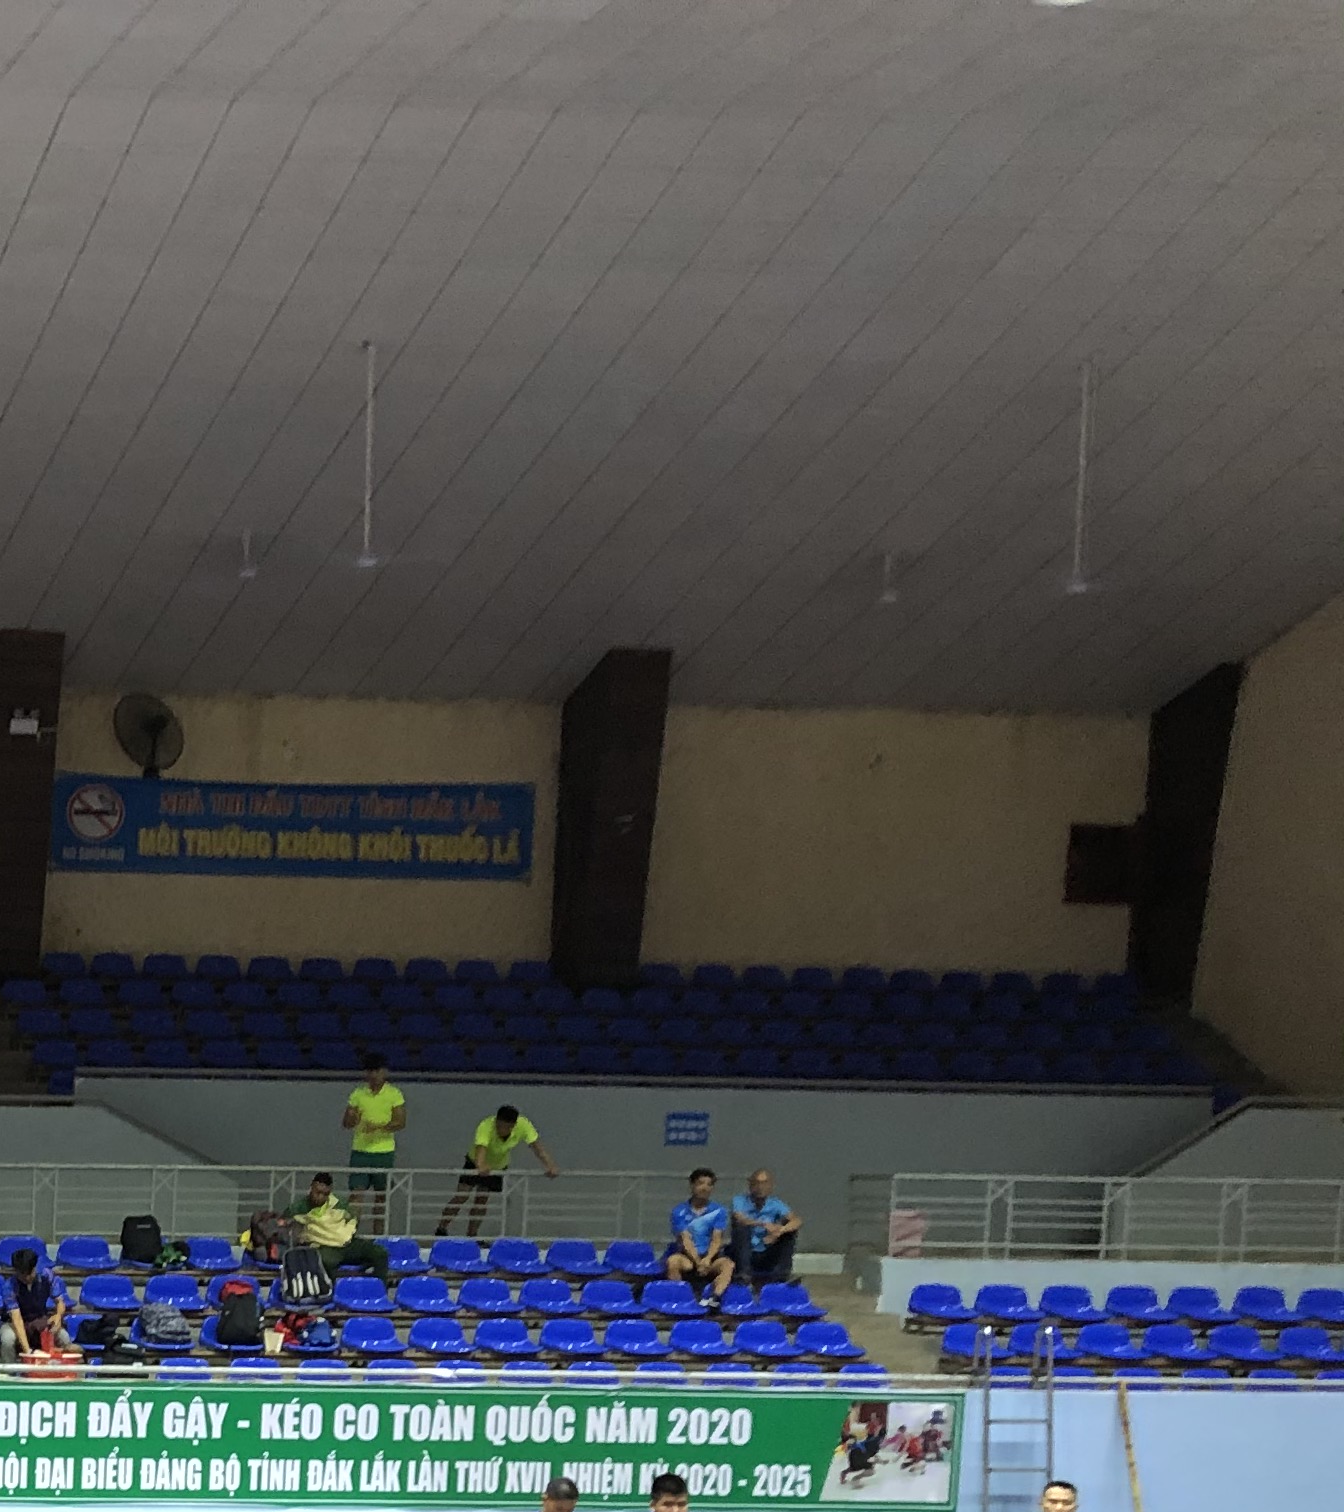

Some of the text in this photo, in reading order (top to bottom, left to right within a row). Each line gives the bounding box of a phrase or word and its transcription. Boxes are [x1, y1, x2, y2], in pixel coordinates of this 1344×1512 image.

[138, 821, 179, 856] MÔI
[493, 829, 520, 863] LÁ
[87, 1388, 154, 1439] ĐẨY
[163, 1396, 229, 1446] GẬY
[237, 1420, 250, 1429] -
[261, 1397, 323, 1441] KÉO
[333, 1403, 380, 1441] CO
[389, 1398, 476, 1442] TOÀN
[484, 1393, 576, 1446] QUỐC
[585, 1400, 658, 1444] NĂM
[666, 1407, 753, 1446] 2020
[34, 1457, 74, 1496] ĐẠI
[81, 1446, 134, 1490] BIỂU
[140, 1450, 202, 1491] ĐẢNG
[208, 1452, 241, 1497] BỘ
[247, 1451, 301, 1492] TỈNH
[307, 1450, 354, 1492] ĐẮK
[360, 1450, 402, 1492] LẮK
[407, 1450, 449, 1493] LẦN
[455, 1456, 504, 1494] THỨ
[504, 1461, 551, 1493] XVII
[562, 1456, 633, 1500] NHIỆM
[752, 1464, 812, 1497] 2025
